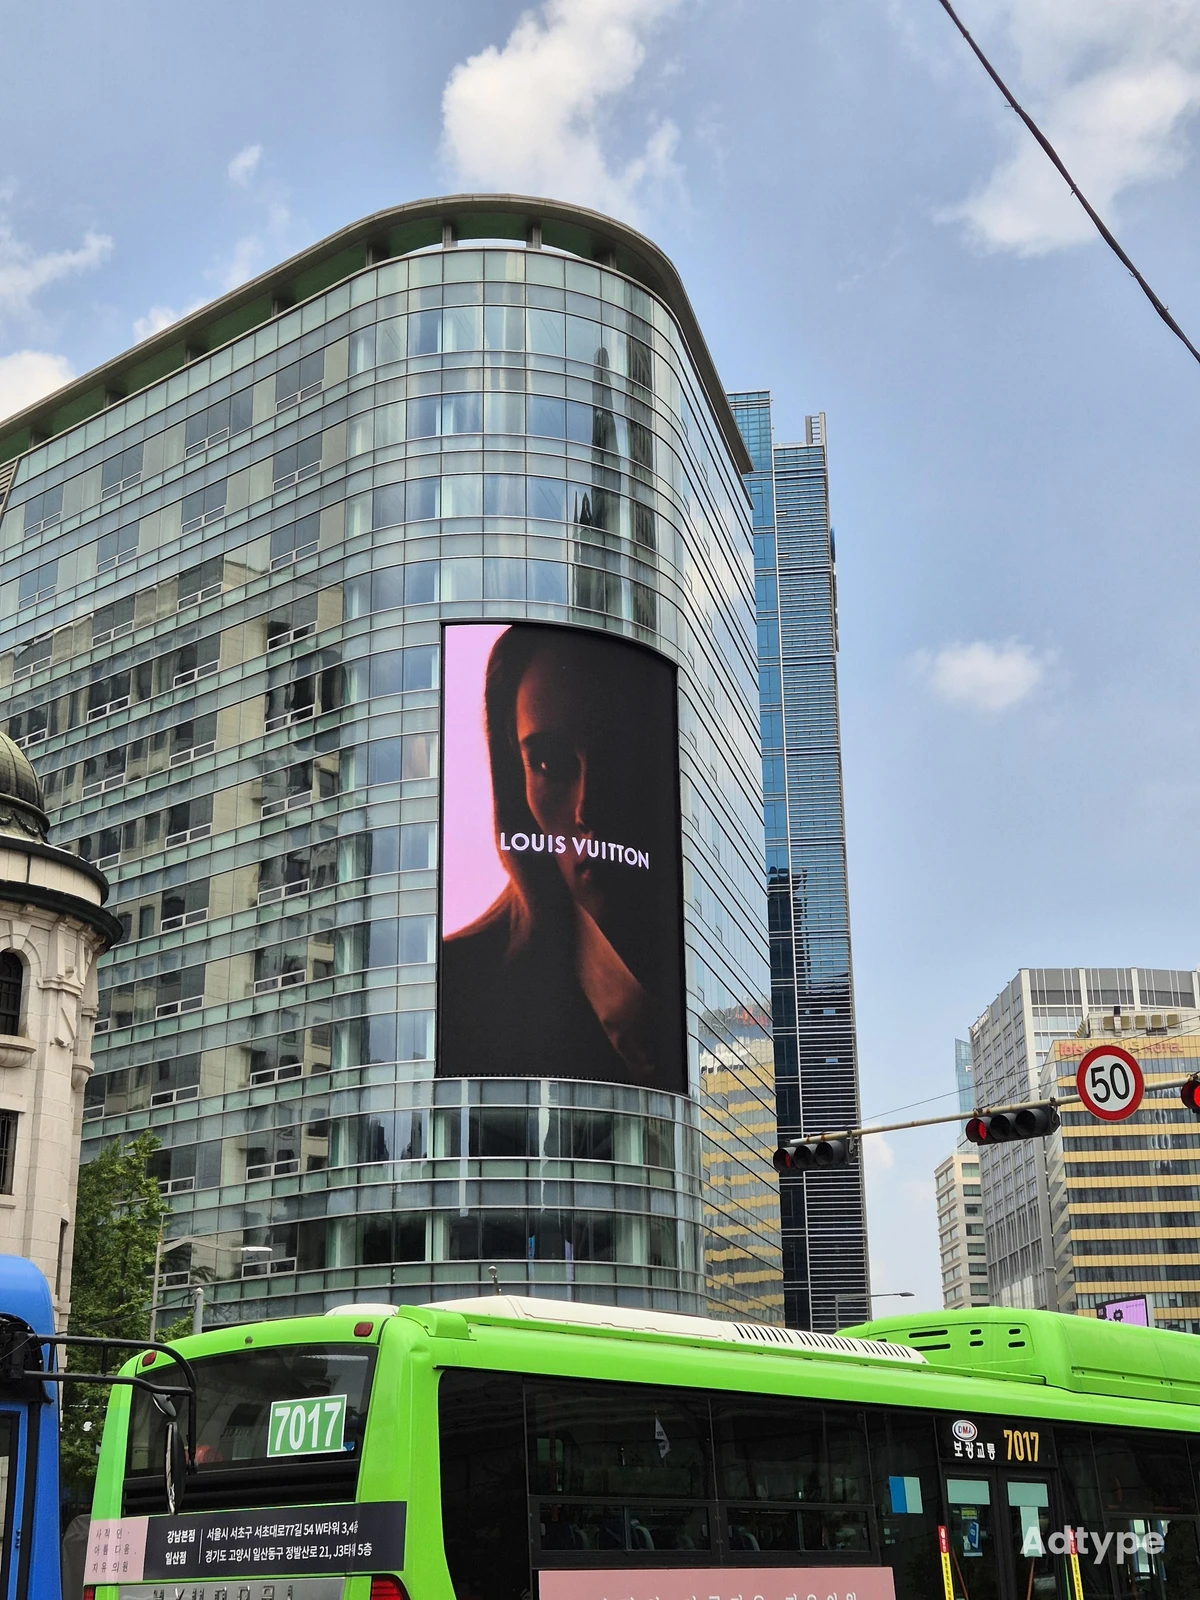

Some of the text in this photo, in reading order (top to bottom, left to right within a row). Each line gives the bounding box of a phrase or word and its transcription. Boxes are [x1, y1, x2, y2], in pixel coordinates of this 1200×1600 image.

[500, 832, 650, 870] LOUIS VUITTON
[1091, 1063, 1130, 1103] 50
[274, 1402, 342, 1452] 7017
[953, 1440, 996, 1461] 보광교통
[1003, 1429, 1039, 1462] 7017
[167, 1528, 196, 1544] 강남본점
[206, 1527, 229, 1541] 서울시
[230, 1526, 253, 1540] 서초구
[254, 1523, 303, 1538] 서초대로77길
[303, 1523, 314, 1536] 54
[315, 1521, 340, 1536] W타워
[165, 1551, 187, 1565] 일산점
[205, 1549, 227, 1563] 경기도
[228, 1548, 251, 1562] 고양시
[253, 1546, 284, 1561] 일산동구
[285, 1545, 318, 1560] 정발산로
[319, 1545, 332, 1559] 21,
[357, 1542, 372, 1557] 5층
